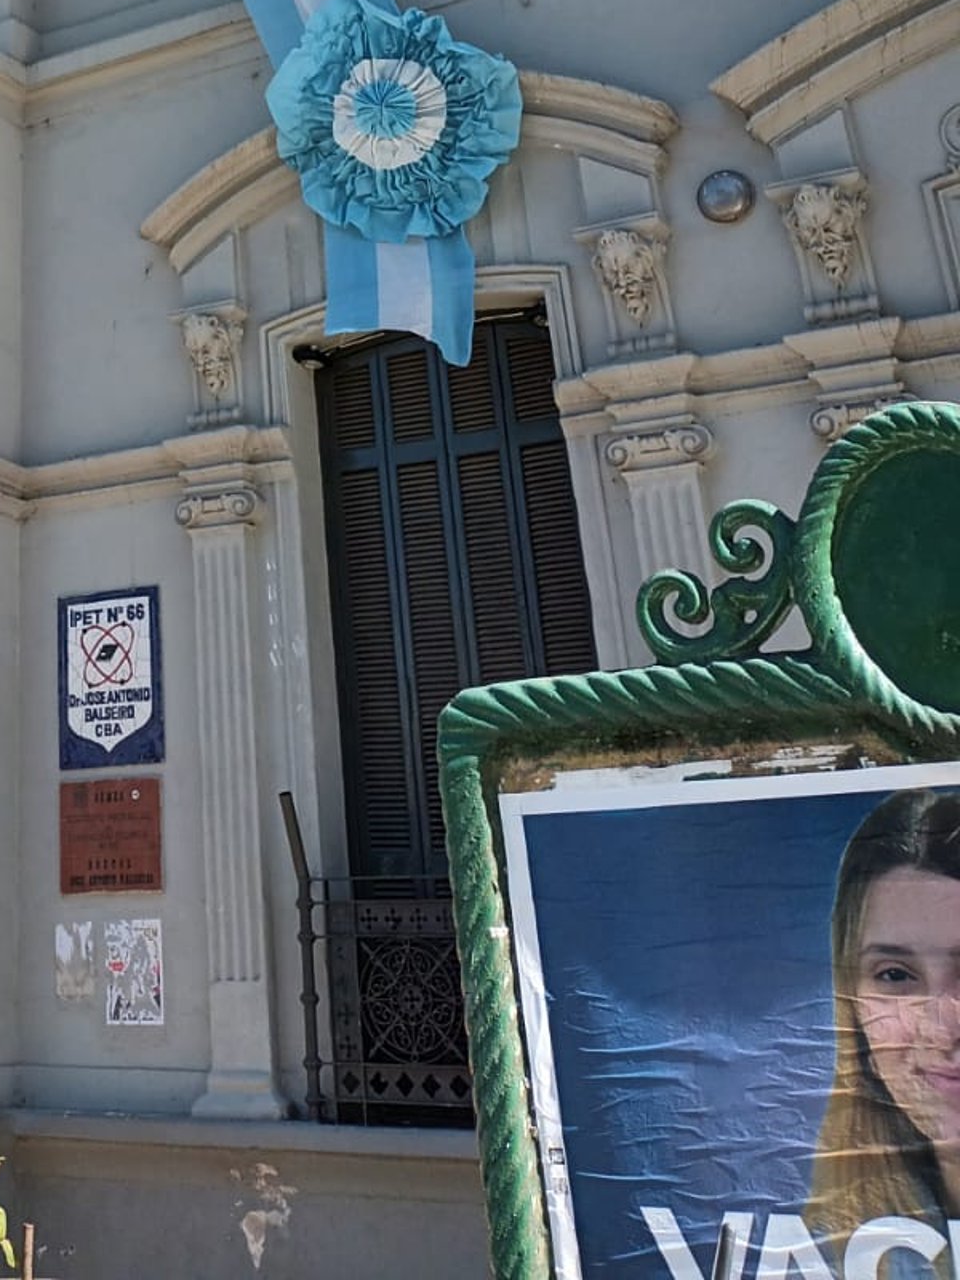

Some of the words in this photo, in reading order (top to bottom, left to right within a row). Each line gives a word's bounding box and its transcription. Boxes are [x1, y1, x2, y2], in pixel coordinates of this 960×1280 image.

[70, 608, 104, 628] IPET
[127, 603, 145, 621] 66
[107, 687, 150, 703] ANTONIO
[85, 705, 135, 722] BALSEIRO
[95, 723, 124, 738] CBA
[640, 1206, 960, 1280] VAC
